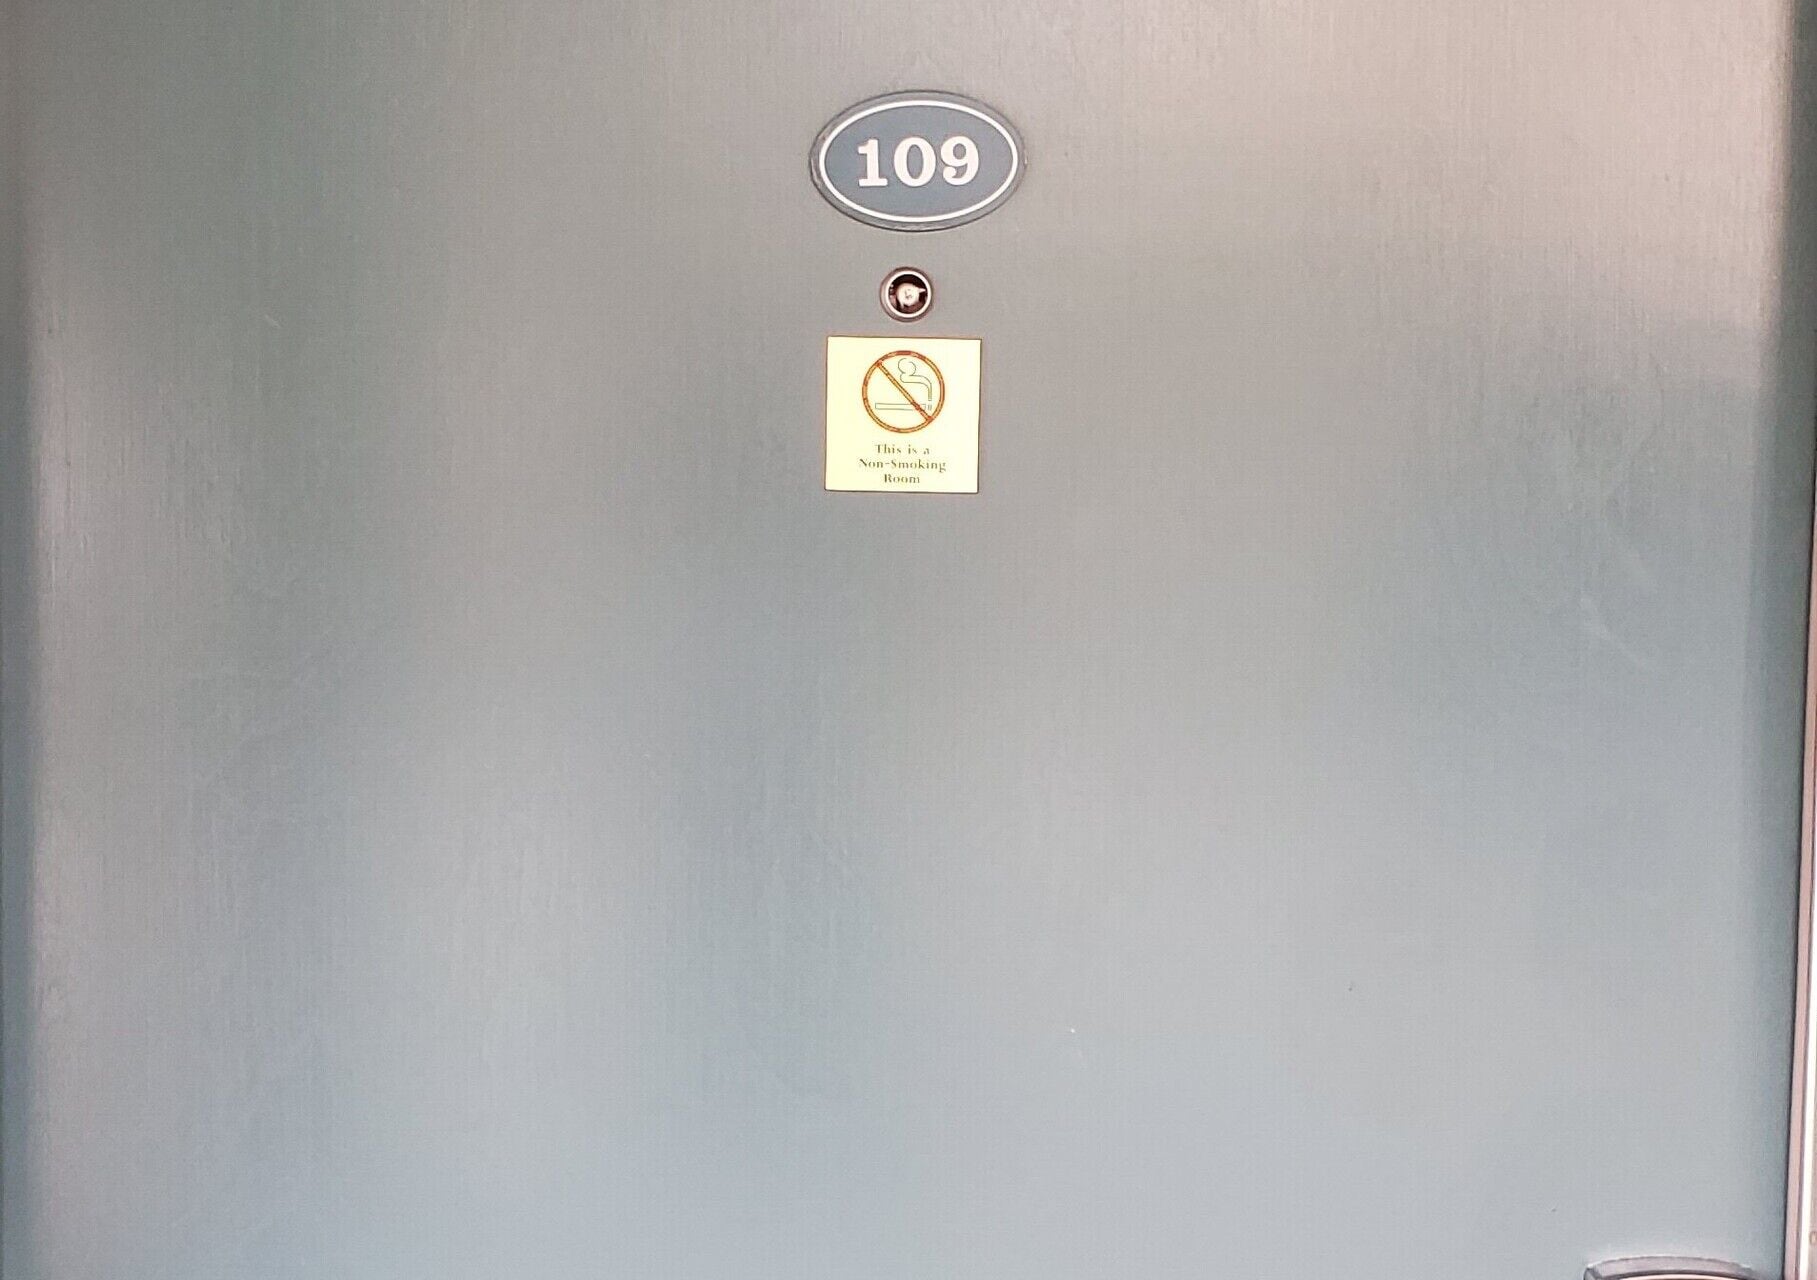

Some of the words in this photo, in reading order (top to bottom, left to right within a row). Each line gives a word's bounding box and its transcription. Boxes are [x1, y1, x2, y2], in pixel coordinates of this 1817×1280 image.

[857, 135, 980, 188] 109
[875, 443, 902, 454] This
[907, 444, 918, 455] is
[923, 447, 931, 455] a
[859, 458, 947, 473] Non-Smoking
[884, 473, 921, 484] Room
